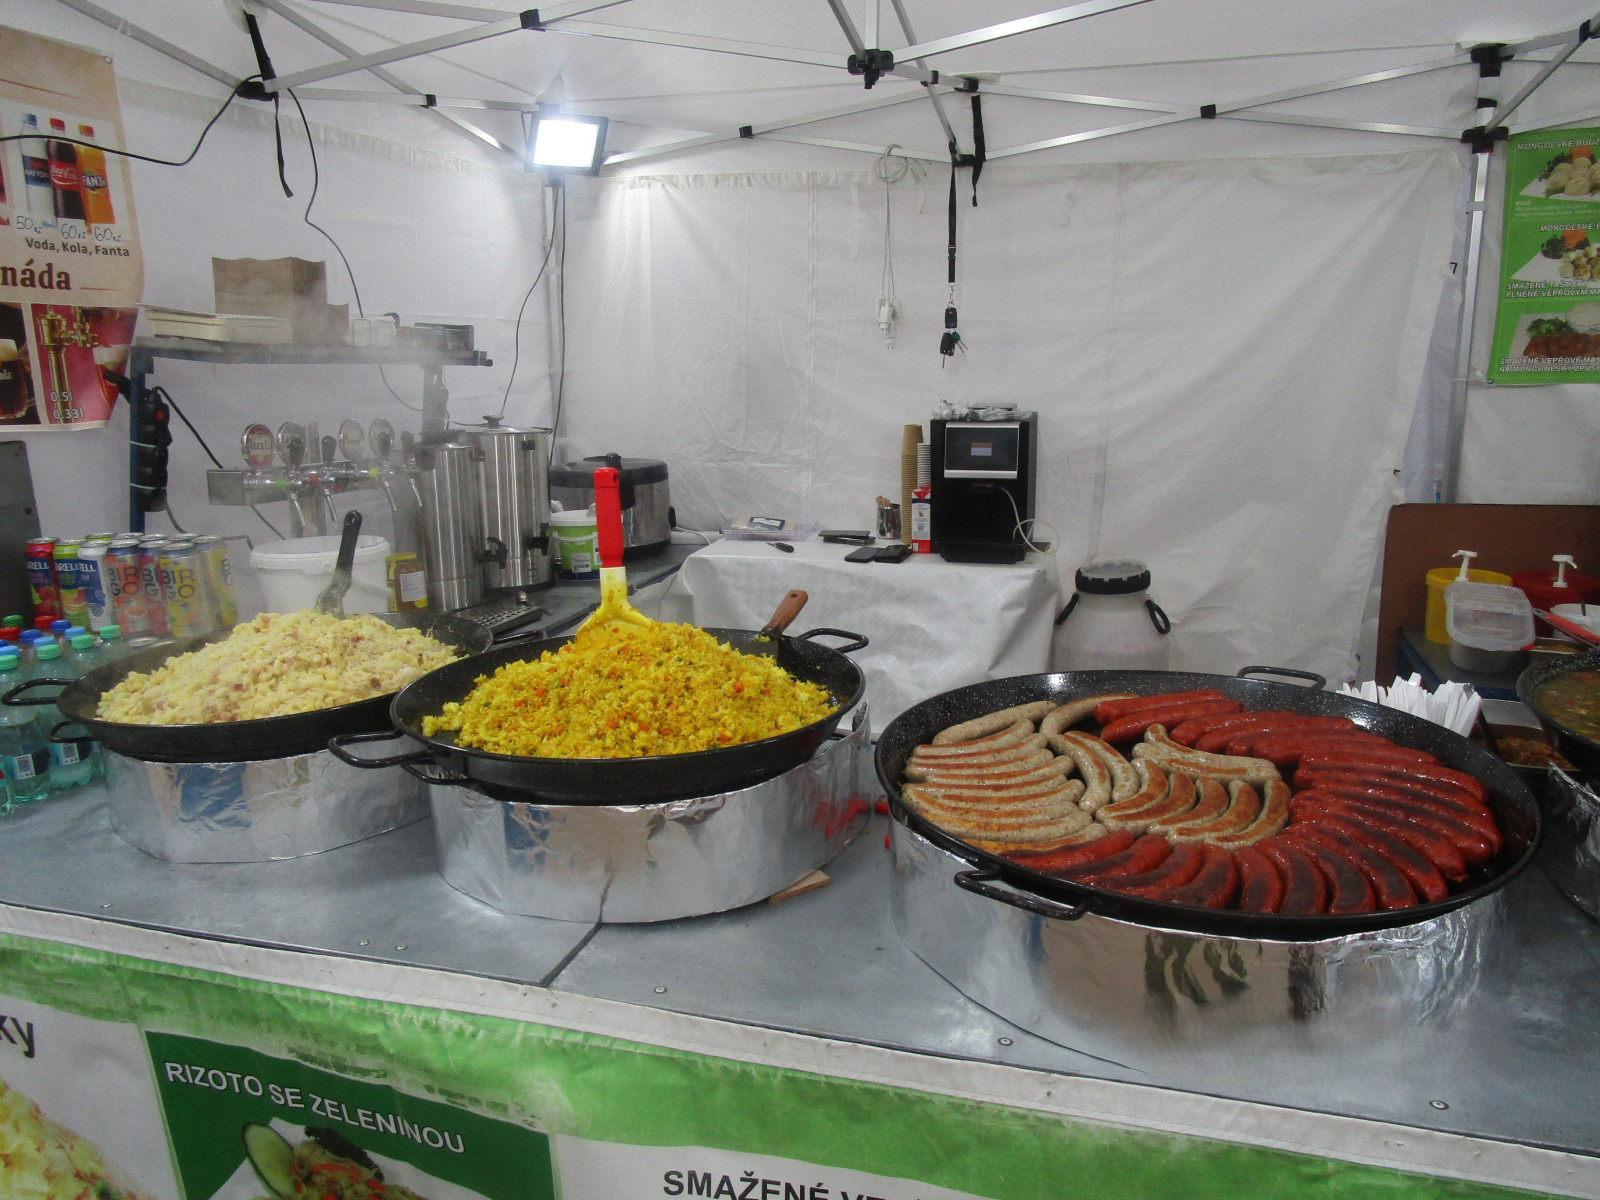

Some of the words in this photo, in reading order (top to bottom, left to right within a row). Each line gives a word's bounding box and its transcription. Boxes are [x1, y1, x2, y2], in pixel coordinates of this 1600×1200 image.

[16, 215, 34, 230] 50
[61, 223, 77, 239] 60
[94, 226, 113, 242] 60
[25, 237, 60, 254] Voda,
[62, 242, 92, 257] Kola,
[94, 245, 130, 257] Fanta
[0, 257, 72, 291] náda
[164, 1061, 264, 1098] RIZOTO
[268, 1082, 304, 1109] SE
[308, 1093, 465, 1154] ZELENINOU
